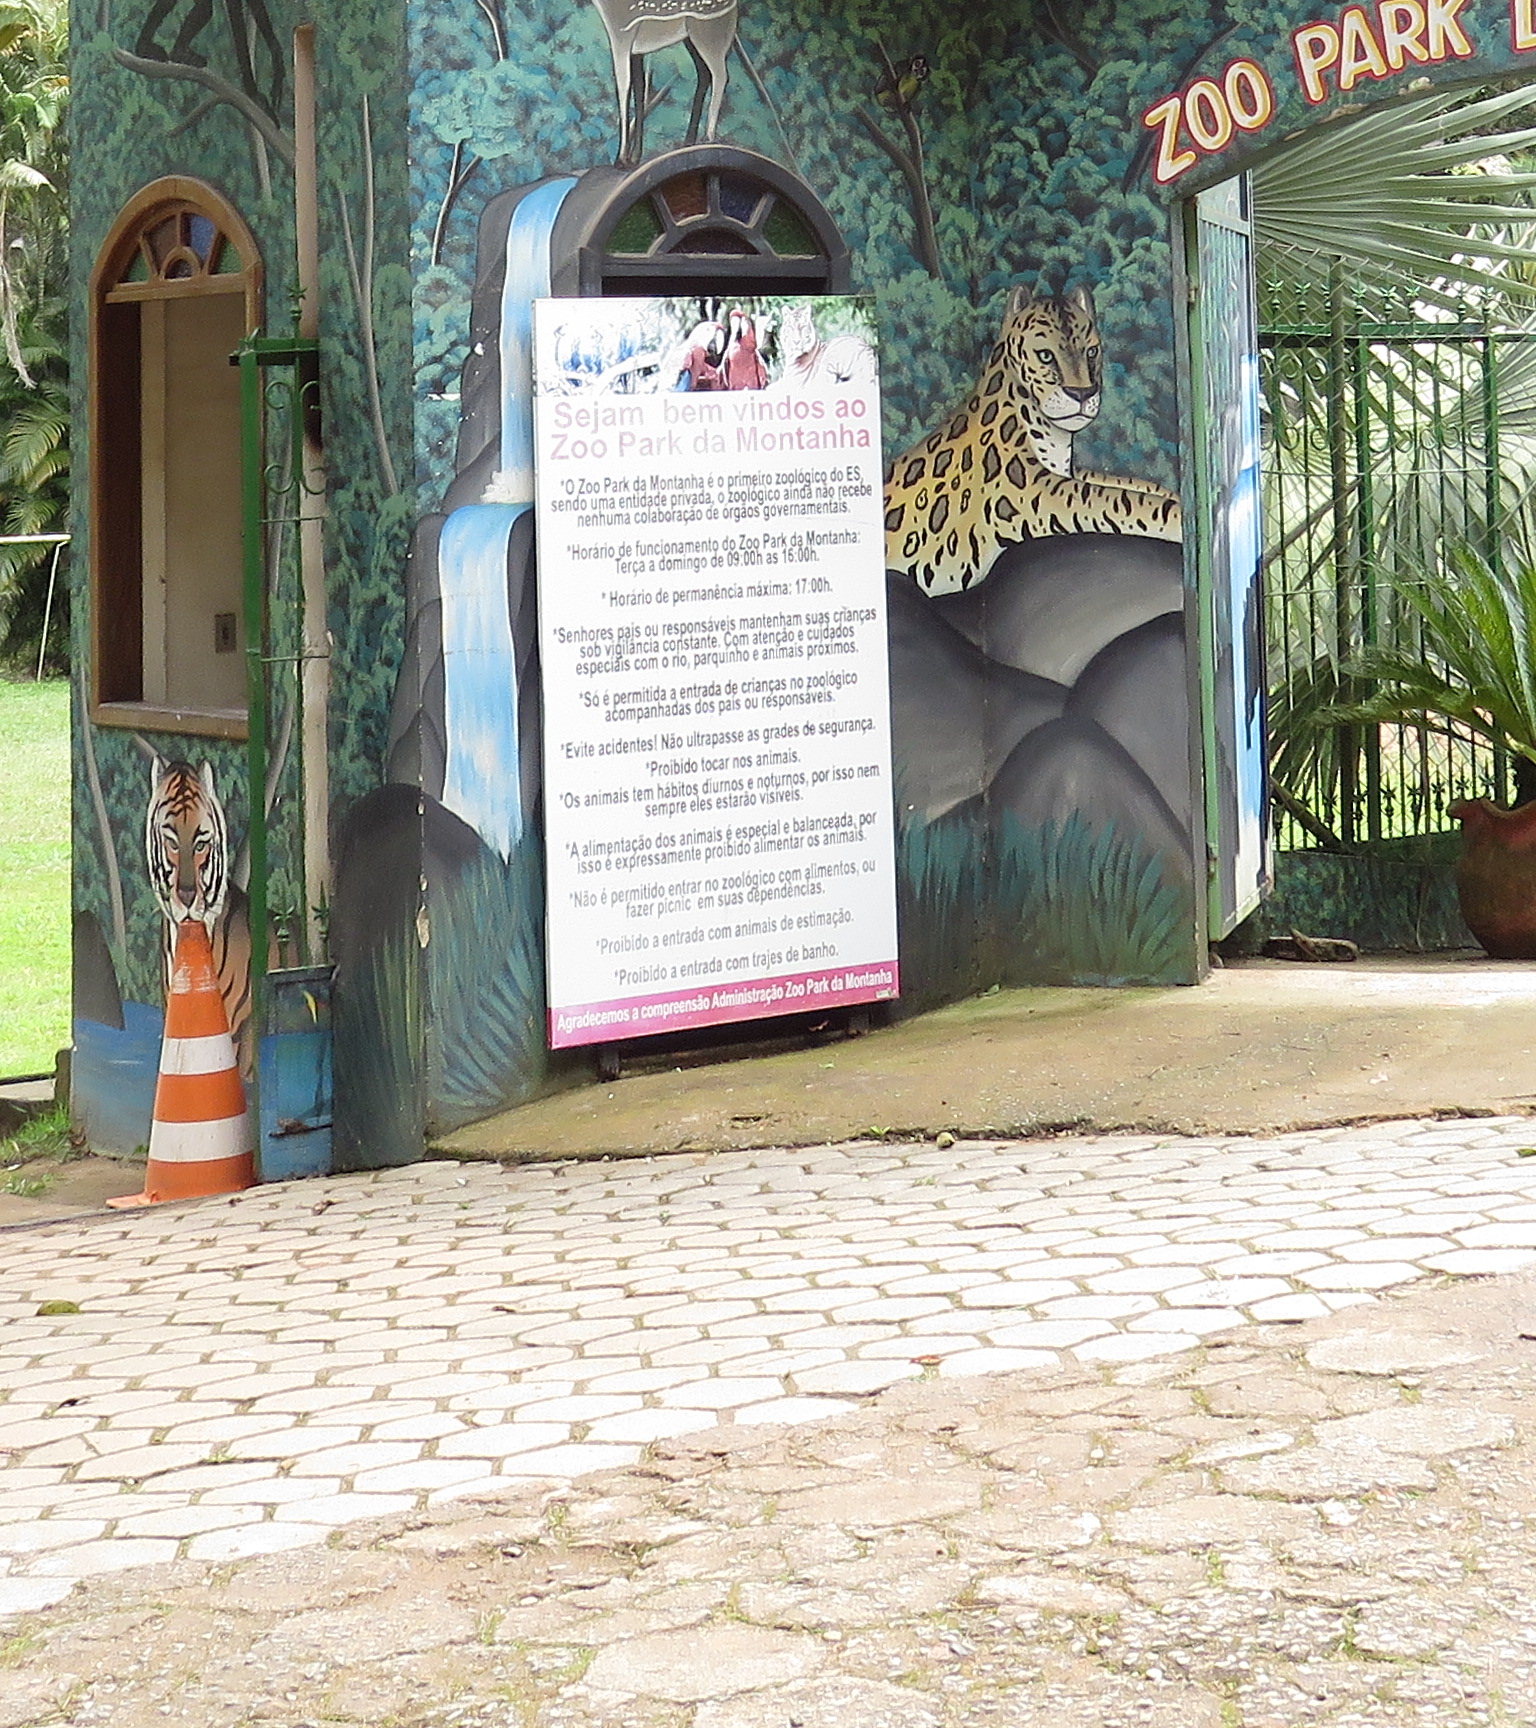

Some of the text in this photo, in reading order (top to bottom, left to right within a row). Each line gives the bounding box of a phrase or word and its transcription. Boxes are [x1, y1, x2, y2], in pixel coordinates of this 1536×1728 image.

[1143, 58, 1274, 185] ZOO
[554, 395, 866, 432] Sejam bem vindos ao
[550, 424, 870, 459] Zoo Park da Montanha
[551, 495, 586, 511] sendo
[591, 497, 615, 509] uma
[619, 491, 667, 508] entidade
[728, 486, 780, 504] zoológico
[783, 485, 812, 499] ainda
[815, 484, 834, 498] não
[838, 482, 871, 497] recebe
[578, 479, 599, 494] Zoo
[604, 477, 629, 492] Park
[632, 477, 646, 491] da
[650, 474, 704, 490] Montanha
[727, 471, 772, 490] primeiro
[775, 469, 826, 486] zoológico
[830, 468, 843, 482] do
[577, 510, 630, 526] nenhuma
[634, 506, 702, 524] colaboração
[705, 505, 719, 519] de
[722, 503, 759, 521] órgãos
[618, 542, 632, 557] de
[635, 537, 718, 556] funcionamento
[722, 536, 735, 550] do
[738, 535, 759, 549] Zoo
[763, 533, 786, 548] Park
[789, 532, 803, 546] da
[615, 558, 645, 574] Terça
[658, 554, 706, 571] domingo
[710, 552, 723, 567] de
[727, 550, 762, 566] 09:00h
[610, 589, 651, 606] Horário
[655, 588, 668, 603] de
[672, 583, 743, 604] permanência
[617, 622, 641, 641] pais
[662, 615, 735, 636] responsáveis
[739, 611, 801, 629] mantenham
[805, 612, 830, 624] suas
[833, 607, 876, 623] crianças
[579, 641, 601, 657] sob
[604, 638, 658, 658] vigilância
[723, 632, 748, 646] Com
[752, 628, 794, 645] atenção
[807, 624, 854, 640] cuidados
[575, 656, 630, 676] especiais
[634, 657, 658, 670] com
[693, 647, 749, 668] parquinho
[762, 643, 803, 659] animais
[613, 686, 666, 707] permitida
[680, 681, 721, 698] entrada
[724, 680, 738, 695] de
[741, 678, 786, 694] crianças
[806, 670, 857, 688] zoológico
[605, 701, 691, 722] acompanhadas
[694, 699, 714, 713] dos
[718, 696, 740, 714] pais
[661, 733, 683, 749] Não
[686, 731, 743, 747] ultrapasse
[762, 723, 799, 742] grades
[802, 721, 815, 735] de
[700, 757, 728, 771] tocar
[732, 756, 752, 768] nos
[584, 788, 628, 806] animais
[632, 786, 654, 801] tem
[657, 781, 698, 799] hábitos
[701, 779, 743, 794] diurnos
[811, 770, 829, 785] por
[832, 766, 854, 780] isso
[857, 765, 879, 777] nem
[644, 801, 686, 816] sempre
[690, 796, 712, 811] eles
[715, 791, 756, 808] estarão
[582, 835, 652, 856] alimentação
[655, 833, 676, 848] dos
[679, 827, 722, 845] animais
[736, 820, 780, 840] especial
[859, 812, 876, 828] por
[577, 859, 601, 874] isso
[615, 846, 701, 871] expressamente
[704, 840, 750, 862] proibido
[753, 834, 804, 853] alimentar
[611, 883, 664, 906] permitido
[668, 879, 702, 896] entrar
[722, 870, 775, 889] zoológico
[778, 869, 801, 882] com
[626, 903, 654, 918] fazer
[658, 896, 691, 917] picnic
[697, 896, 714, 909] em
[717, 892, 743, 906] suas
[662, 927, 704, 946] entrada
[708, 926, 732, 939] com
[735, 917, 777, 936] animais
[780, 915, 793, 930] de
[680, 957, 722, 976] entrada
[725, 956, 749, 970] com
[752, 950, 782, 967] trajes
[785, 947, 798, 961] de
[557, 969, 891, 1033] Agradecemos compreensão Administração Zoo Park da Montanha
